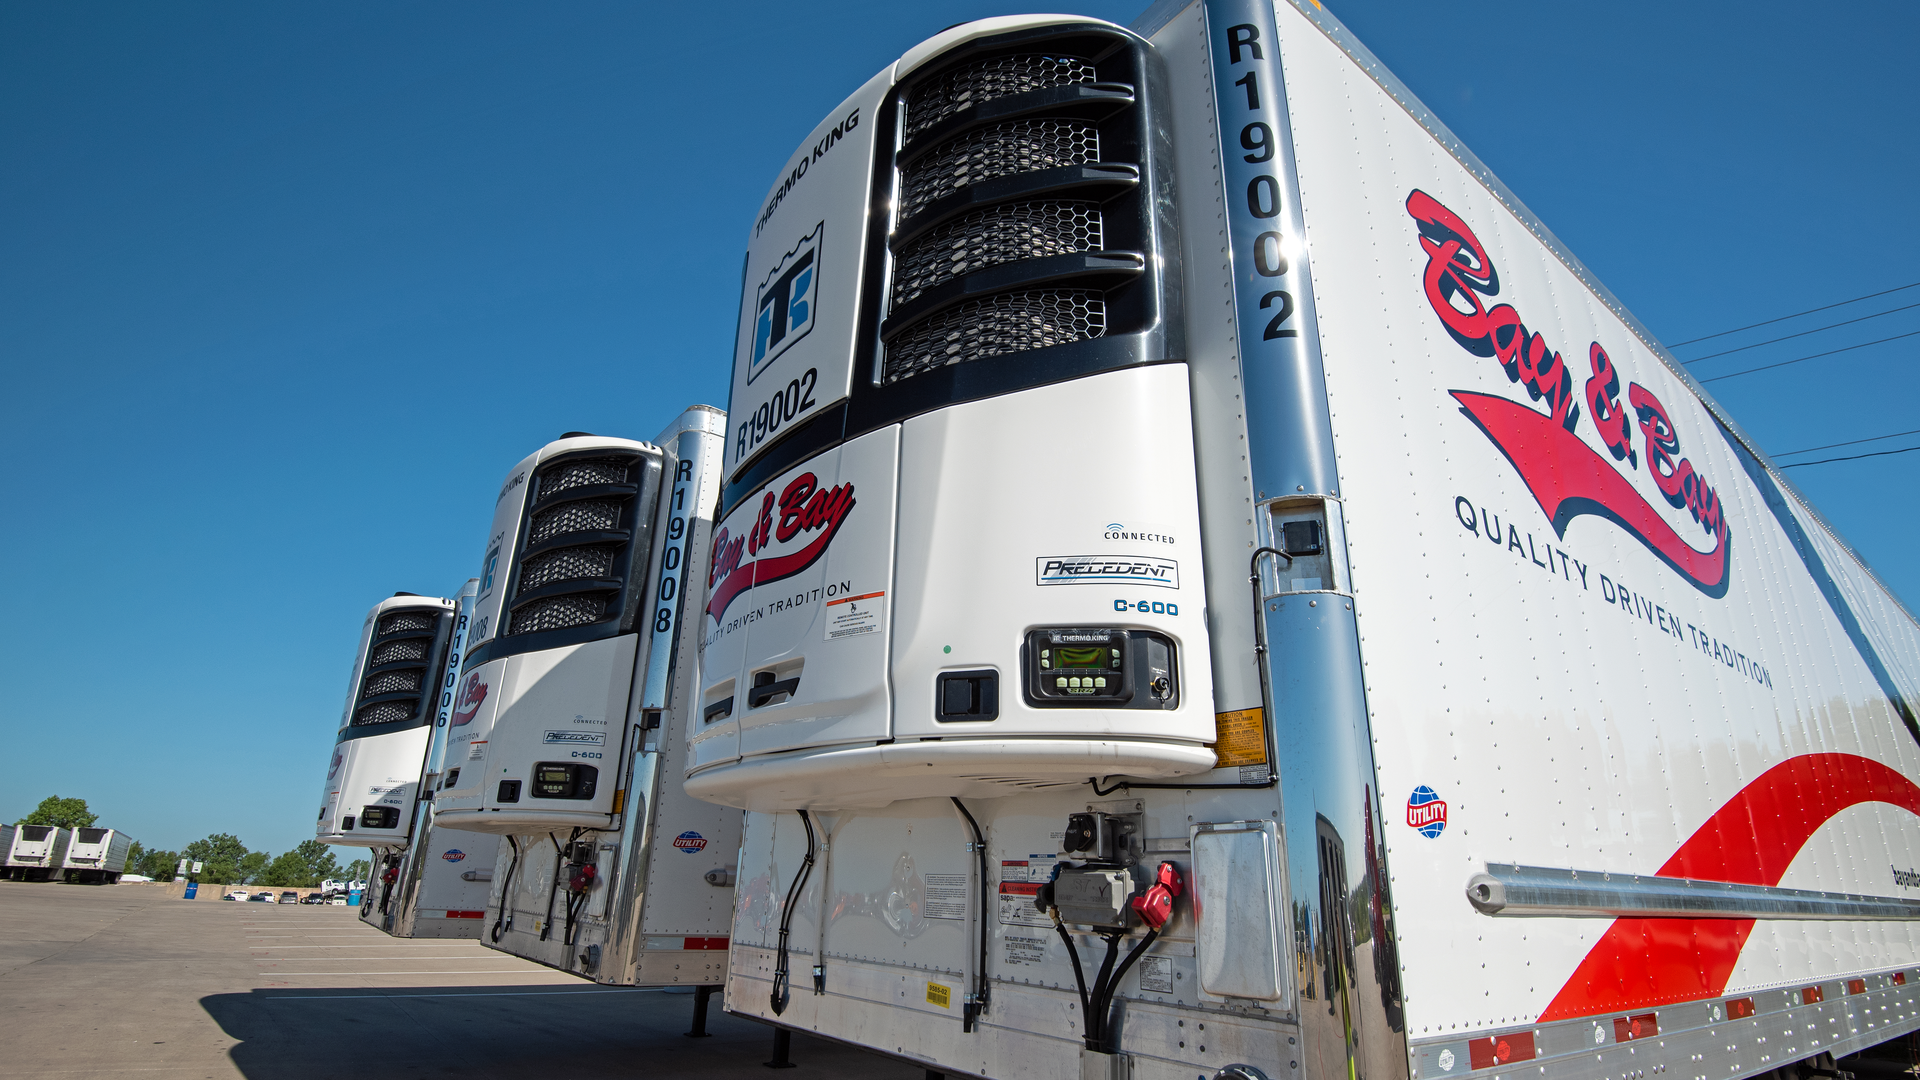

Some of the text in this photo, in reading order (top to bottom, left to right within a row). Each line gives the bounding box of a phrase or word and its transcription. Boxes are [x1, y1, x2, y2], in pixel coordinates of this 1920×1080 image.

[756, 107, 860, 239] THERMO KING
[1227, 23, 1298, 341] R19002
[1406, 188, 1731, 536] Bay & Bay
[735, 367, 818, 464] R19002
[656, 459, 694, 633] R19008
[748, 491, 775, 557] &
[776, 472, 857, 543] Bay
[1104, 531, 1175, 545] CONNECTED
[1043, 560, 1174, 577] PRECEDENT
[1455, 495, 1773, 691] QUALITY DRIVEN TRADITION
[727, 608, 763, 634] DRIVEN
[769, 580, 851, 615] TRADITION
[1062, 634, 1091, 642] THERMO
[1092, 634, 1108, 642] KING
[1114, 599, 1178, 616] C-600
[438, 615, 468, 727] R19006
[571, 751, 602, 759] C-600
[675, 839, 706, 847] UTILITY
[1409, 803, 1445, 825] UTILITY
